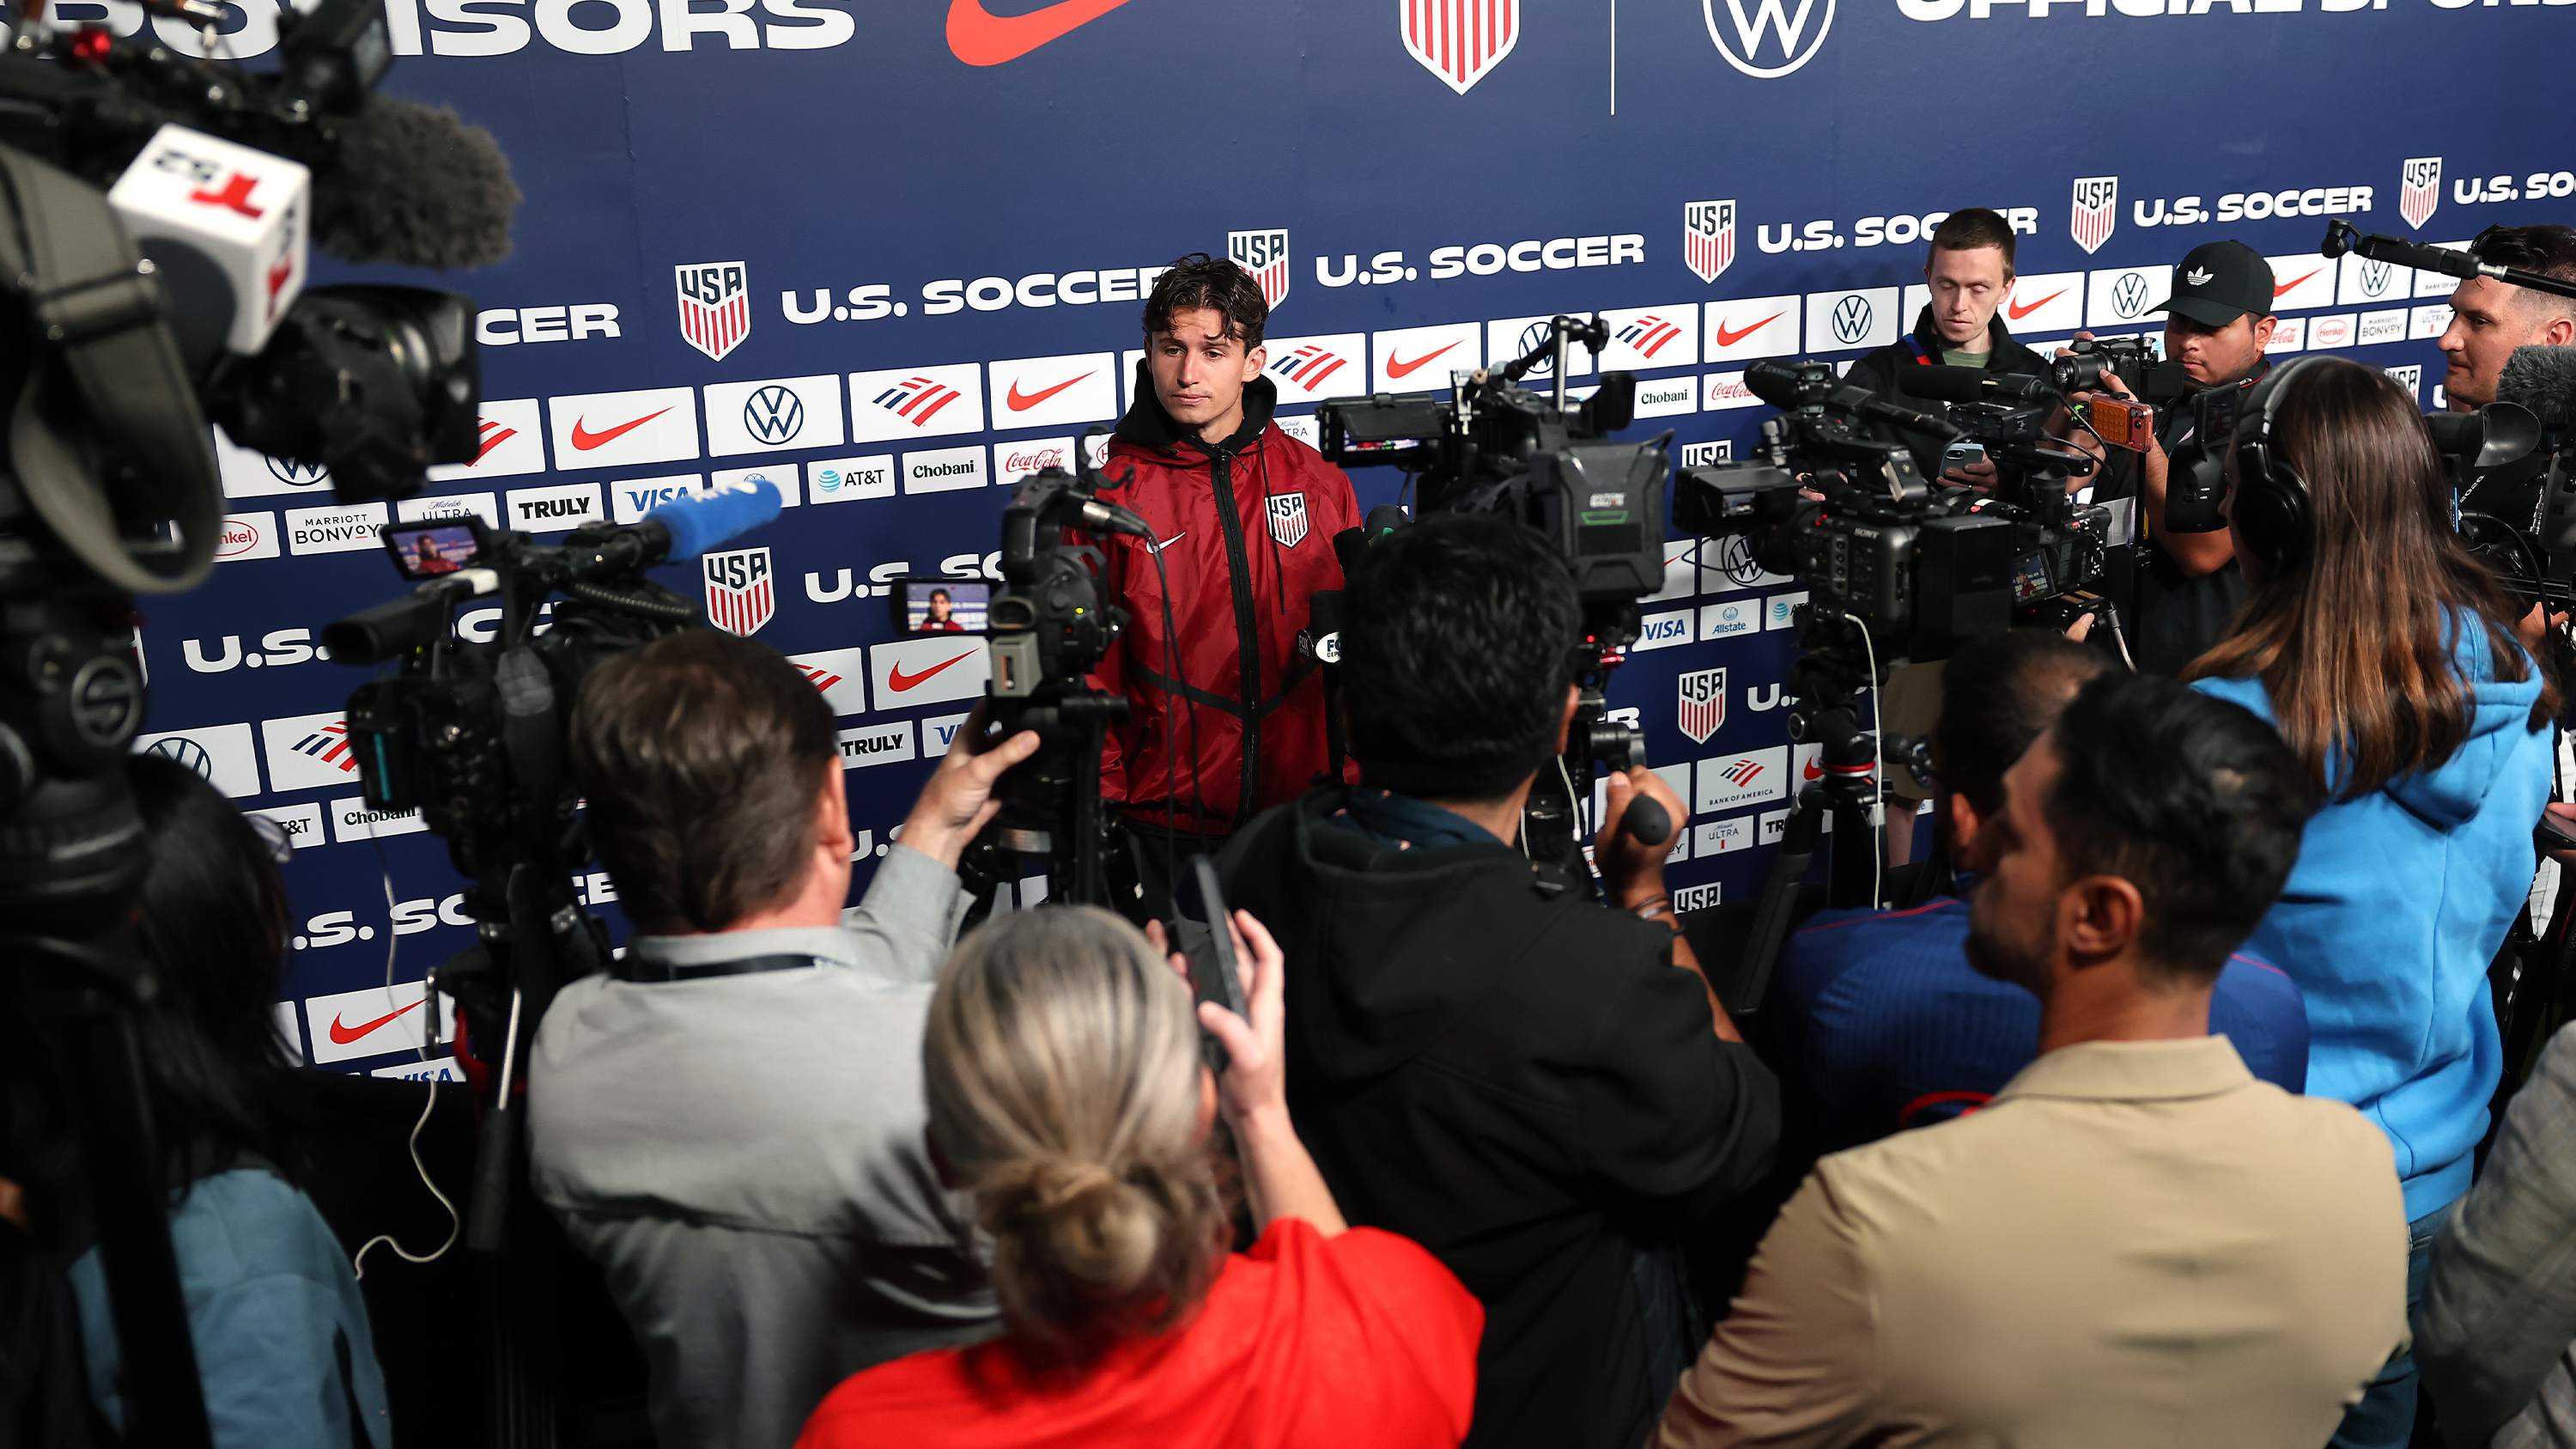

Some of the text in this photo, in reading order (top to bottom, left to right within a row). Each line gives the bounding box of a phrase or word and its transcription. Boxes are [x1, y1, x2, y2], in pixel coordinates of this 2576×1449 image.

[2407, 161, 2439, 189] USA
[2453, 170, 2576, 205] U.S. SO
[2075, 181, 2114, 210] USA
[2134, 186, 2374, 228] U.S. SOCCER
[1689, 204, 1732, 236] USA
[1757, 206, 2039, 254] U.S. SOCER
[1233, 234, 1284, 268] USA
[1315, 233, 1645, 289] U.S. SOCCER
[679, 266, 742, 305] USA
[781, 284, 908, 325] U.S.
[1641, 388, 1688, 405] Chobani
[1285, 427, 1309, 436] TRA
[844, 469, 884, 487] AT&T
[913, 460, 975, 479] Chobani
[305, 514, 368, 527] MARRIOTT
[422, 508, 473, 521] ULTRA
[518, 496, 591, 520] TRULY
[219, 529, 252, 545] nkel
[707, 551, 768, 590] USA
[805, 561, 910, 603] U.S
[1643, 618, 1686, 641] VISA
[1712, 620, 1747, 635] Allstate
[182, 628, 331, 673] U.S.
[1681, 672, 1723, 703] USA
[840, 734, 904, 757] TRULY
[1709, 797, 1729, 806] BANK
[1741, 788, 1774, 801] AMERICA
[1708, 827, 1740, 841] ULTRA
[1677, 886, 1718, 912] USA
